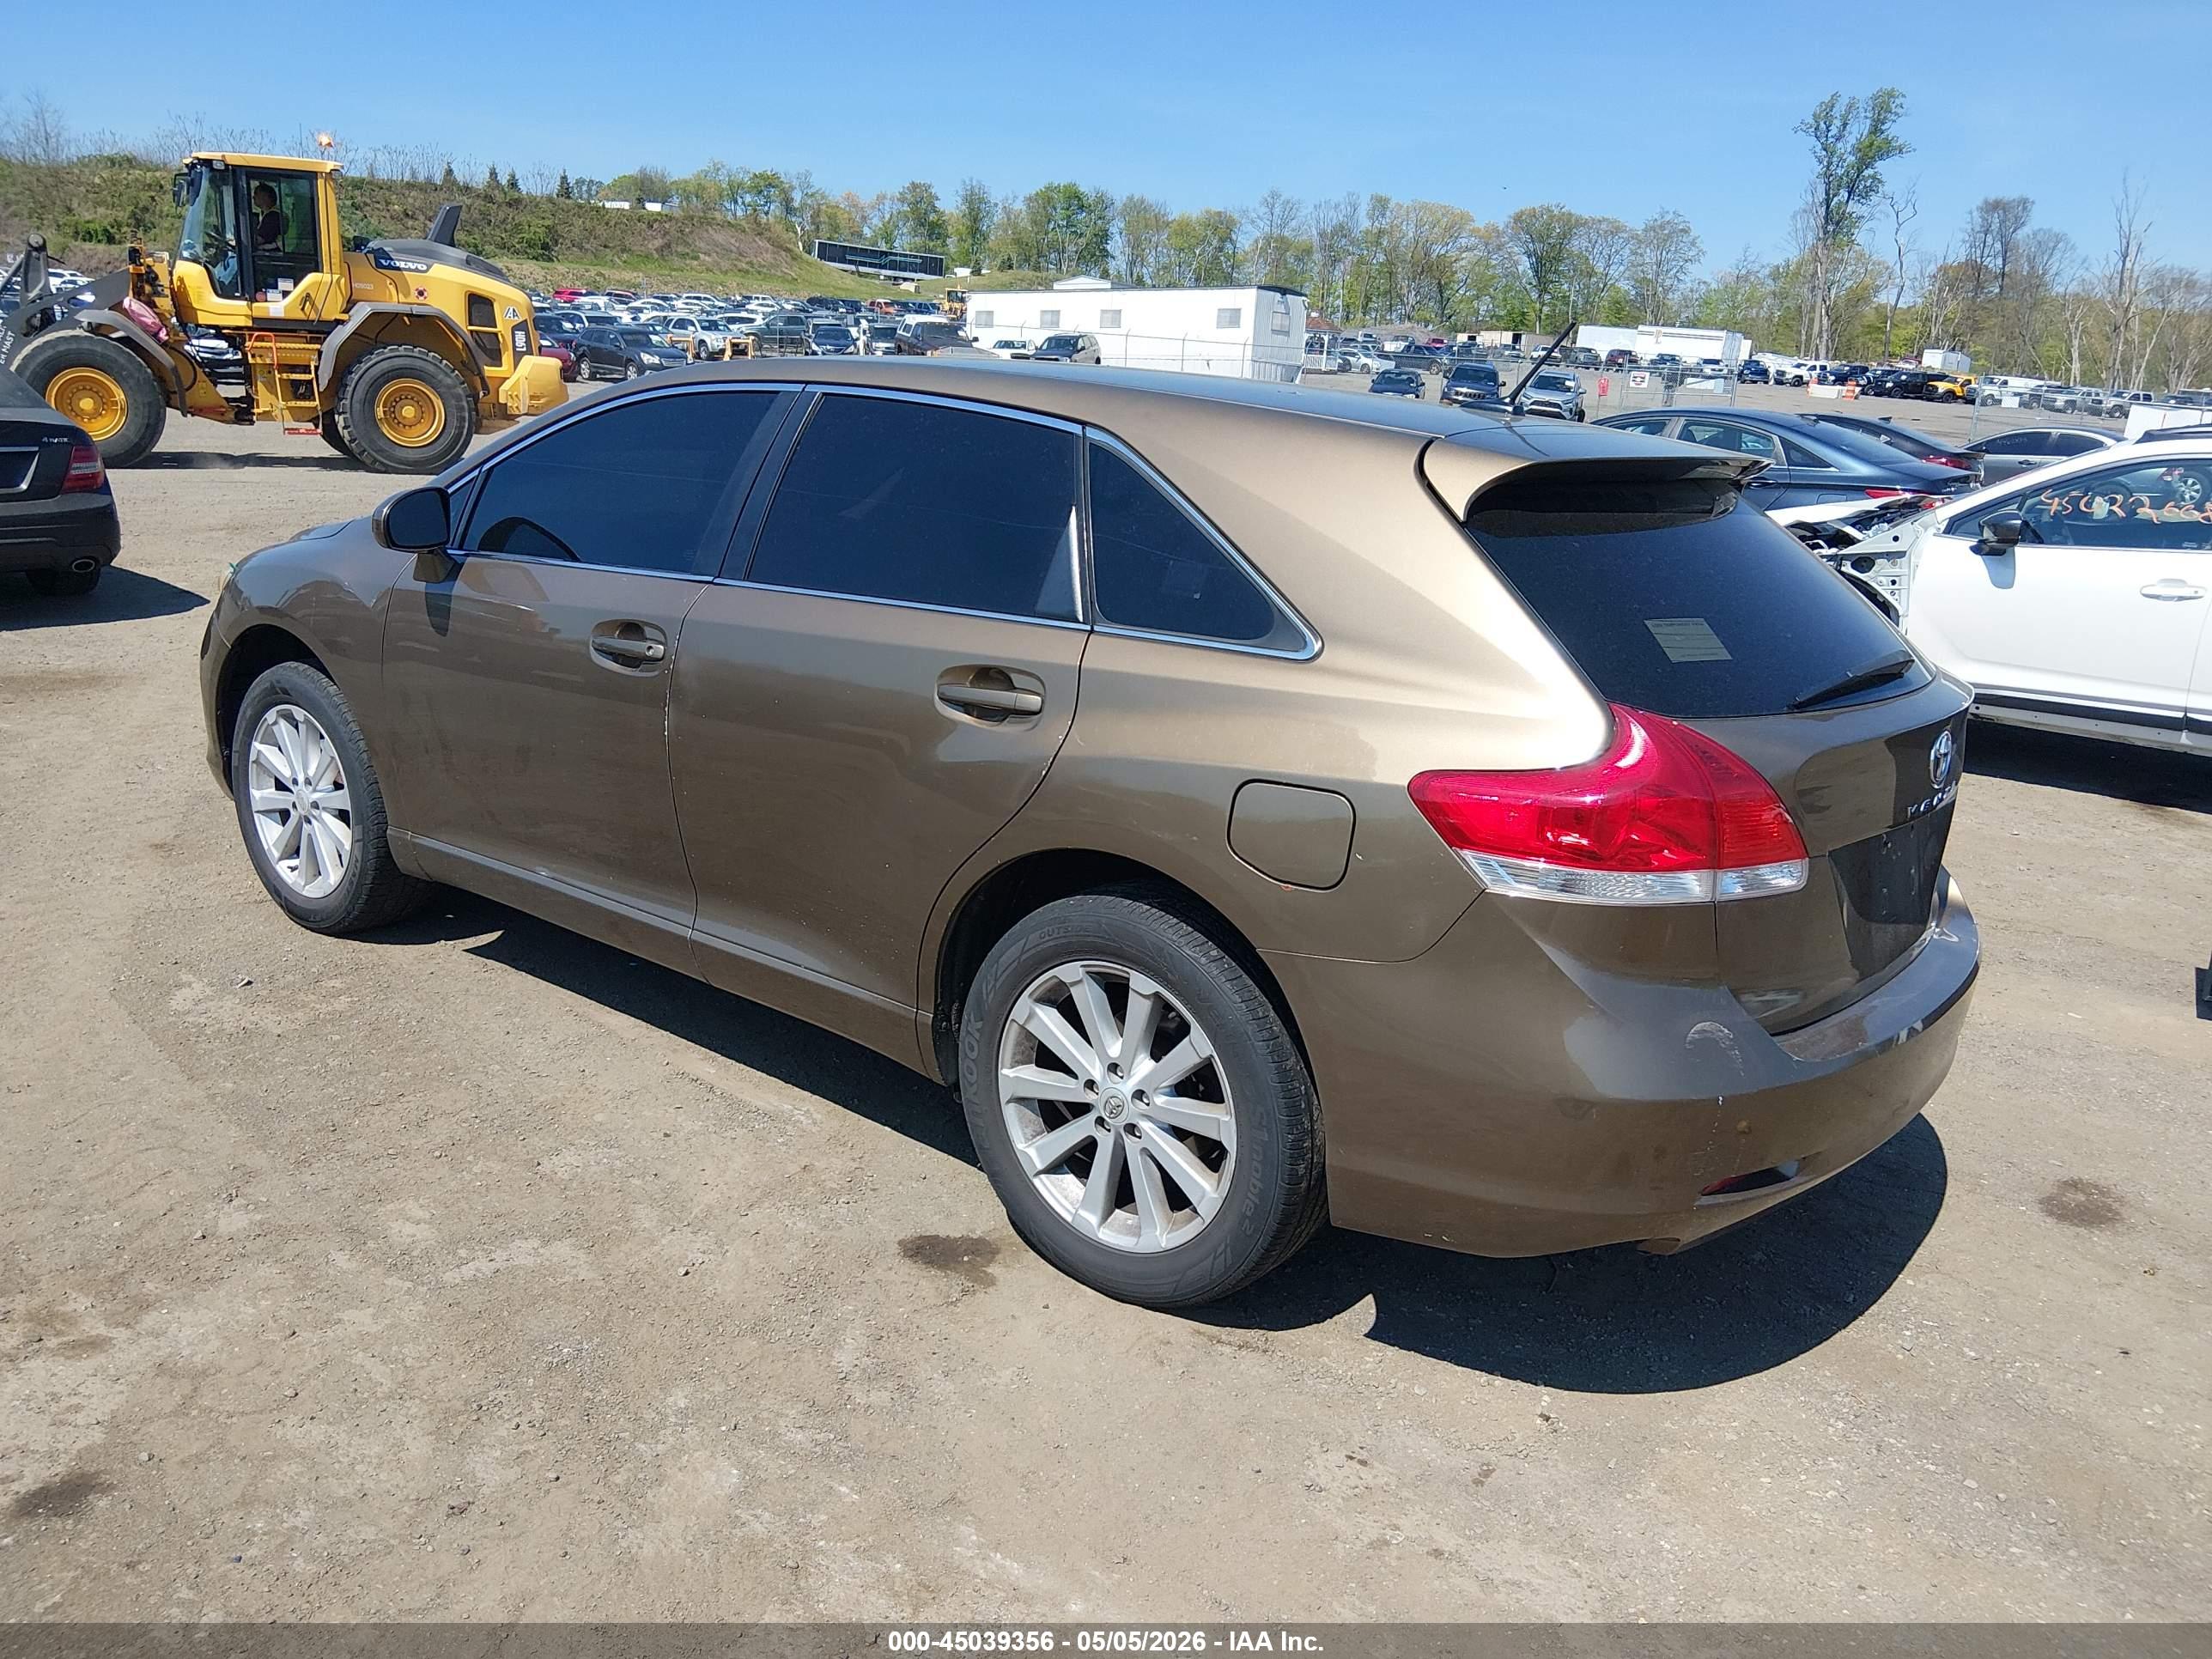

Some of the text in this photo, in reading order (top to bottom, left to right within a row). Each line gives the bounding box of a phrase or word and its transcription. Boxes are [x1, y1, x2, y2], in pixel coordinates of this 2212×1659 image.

[378, 258, 428, 270] VOLVO
[514, 331, 527, 351] L90H
[1039, 924, 1093, 940] OUTSIDE
